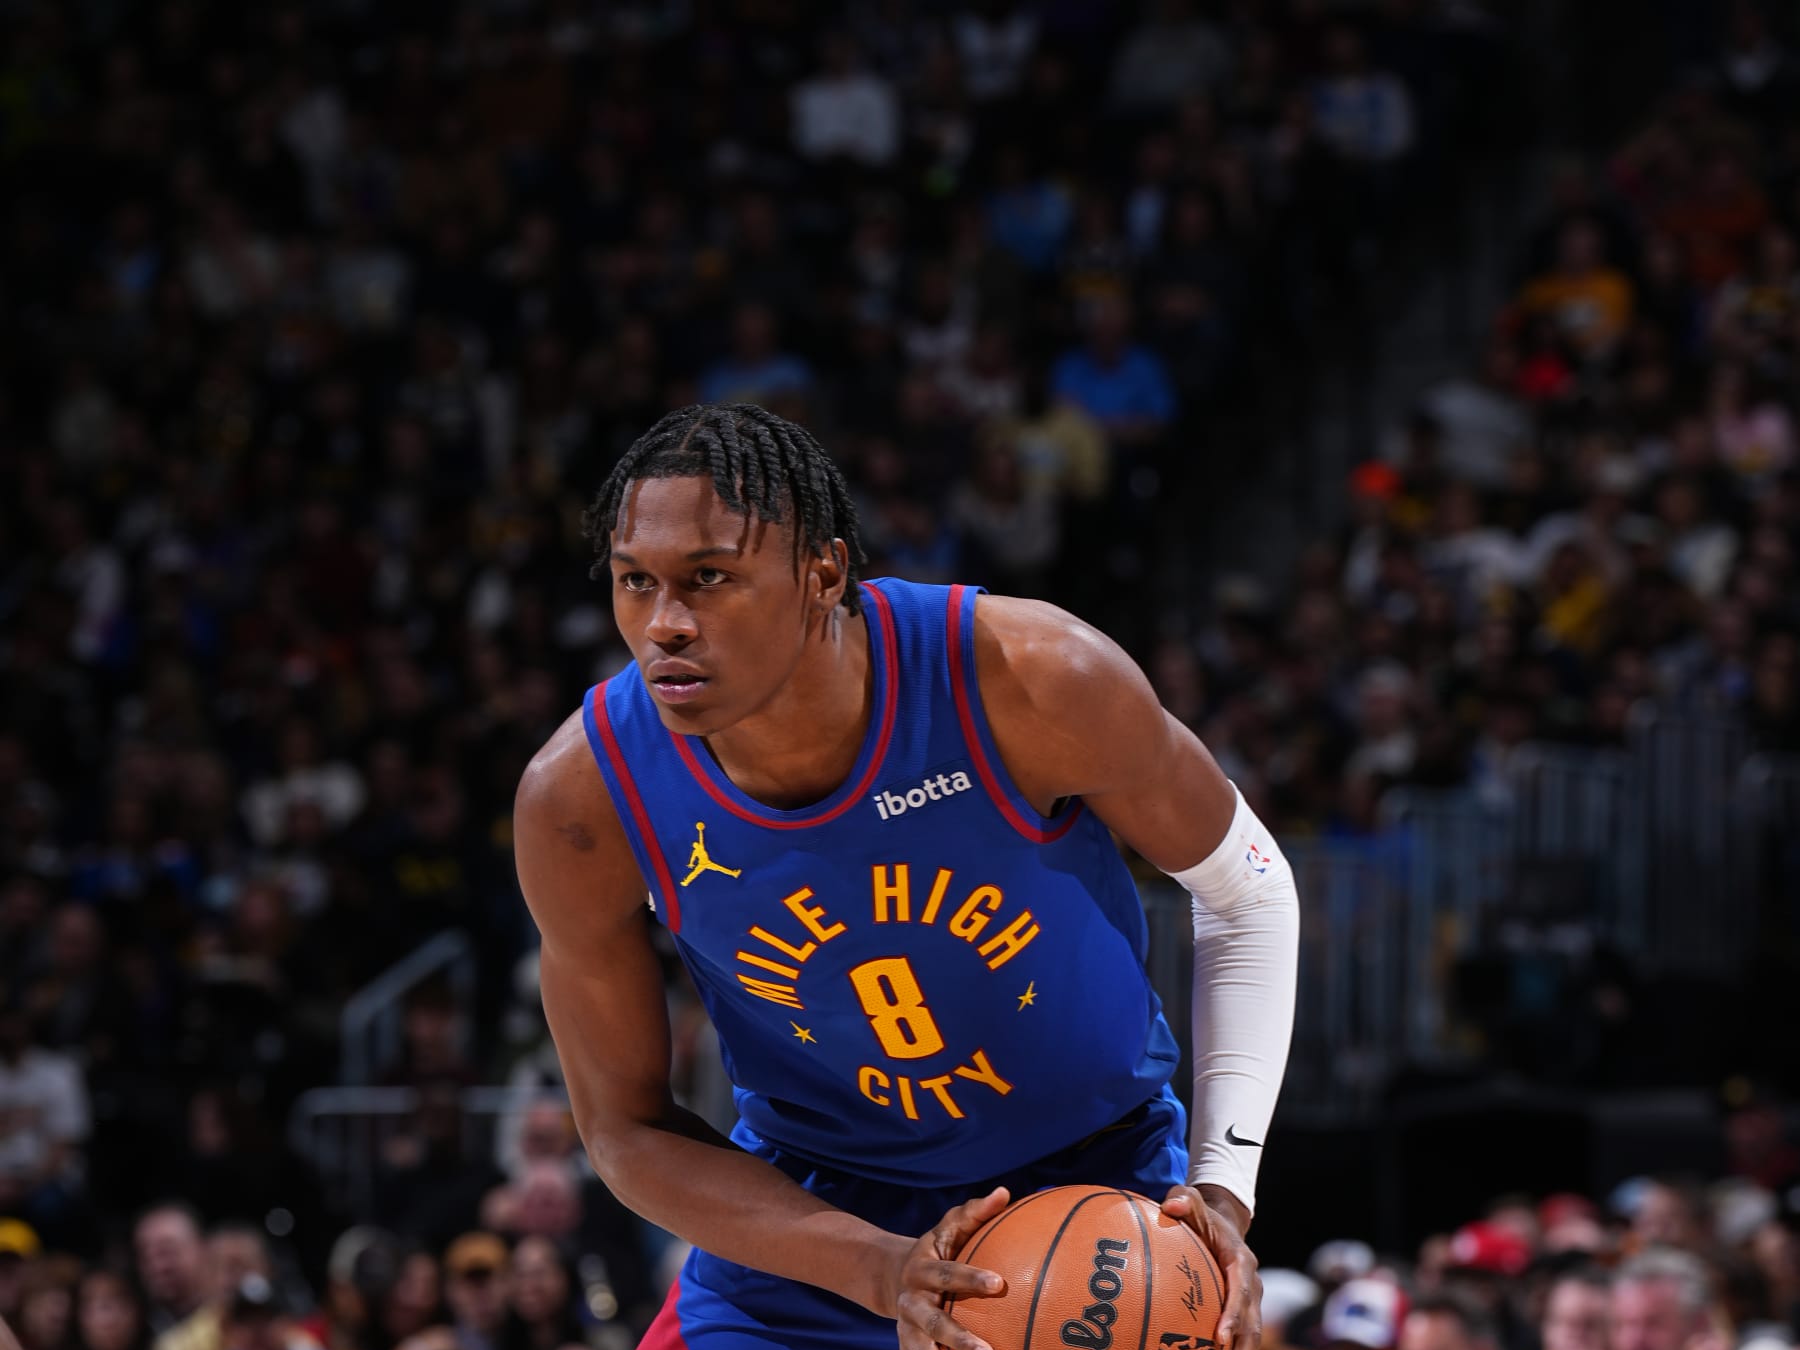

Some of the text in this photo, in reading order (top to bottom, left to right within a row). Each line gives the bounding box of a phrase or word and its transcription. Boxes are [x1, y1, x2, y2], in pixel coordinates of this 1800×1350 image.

[875, 769, 973, 820] ibotta
[736, 864, 1041, 1010] MILE HIGH
[848, 956, 945, 1060] 8
[858, 1048, 1014, 1120] CITY
